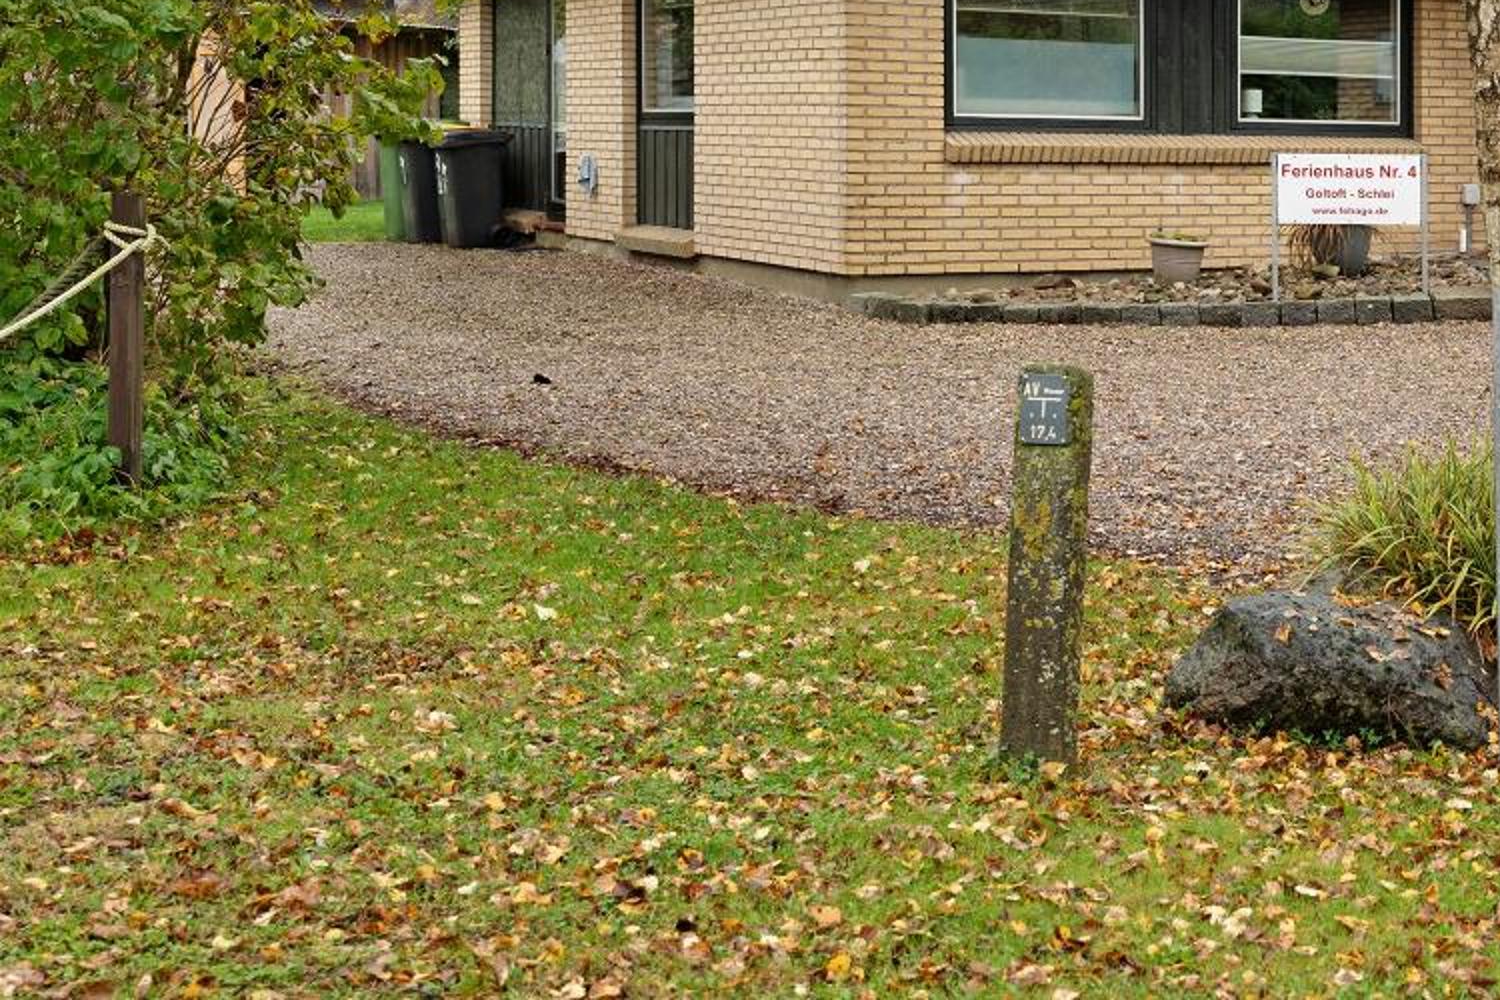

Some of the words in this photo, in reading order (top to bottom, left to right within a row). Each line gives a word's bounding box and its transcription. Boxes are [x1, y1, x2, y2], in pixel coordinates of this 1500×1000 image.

[1281, 163, 1375, 178] Ferienhaus
[1379, 165, 1402, 178] Nr.
[1407, 165, 1417, 178] 4
[1305, 187, 1347, 199] Goltoft
[1357, 187, 1395, 199] Schlei
